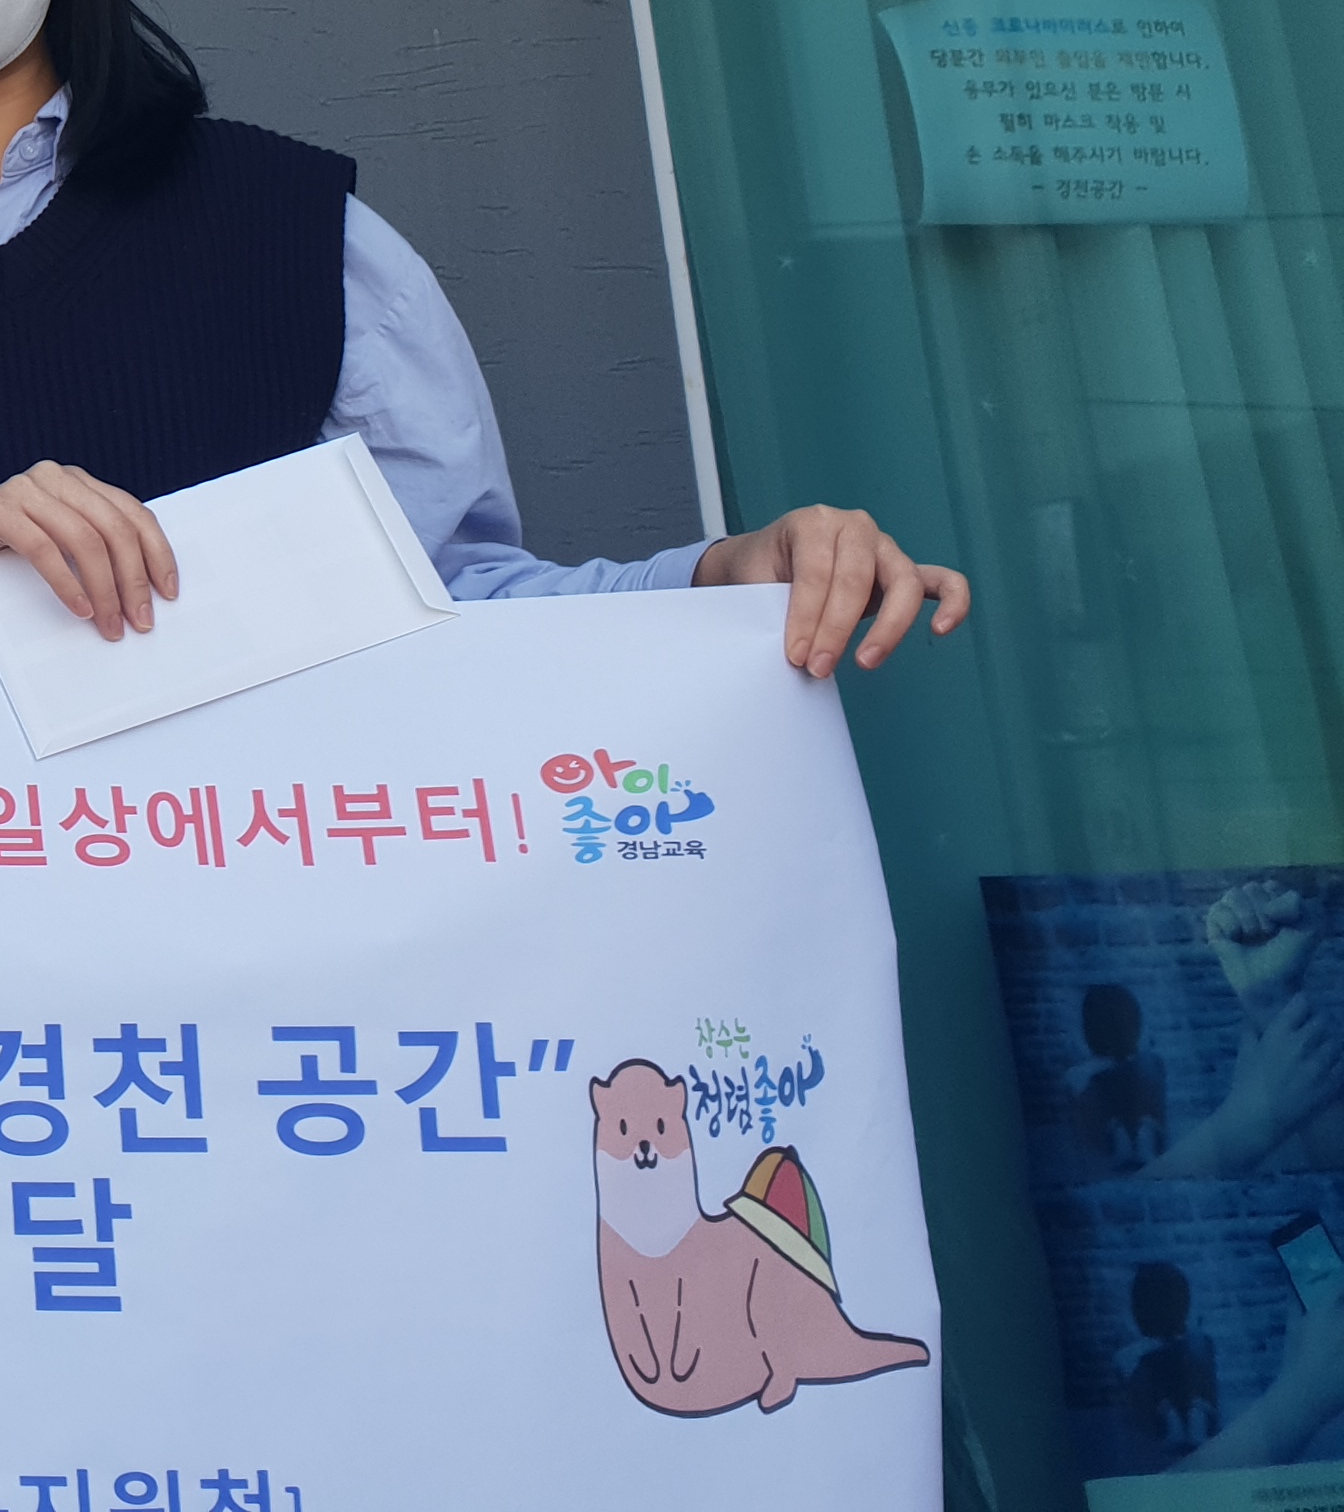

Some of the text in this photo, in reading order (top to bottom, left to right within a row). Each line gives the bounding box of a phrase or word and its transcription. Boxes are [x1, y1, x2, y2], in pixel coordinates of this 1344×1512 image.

[1043, 114, 1095, 131] 마스크
[1133, 147, 1209, 167] 바랍니다.
[1056, 179, 1123, 199] 경천공간
[540, 748, 670, 794] 아이
[562, 789, 715, 864] 좋아
[617, 840, 707, 860] 경남교육
[695, 1017, 751, 1059] 창수는
